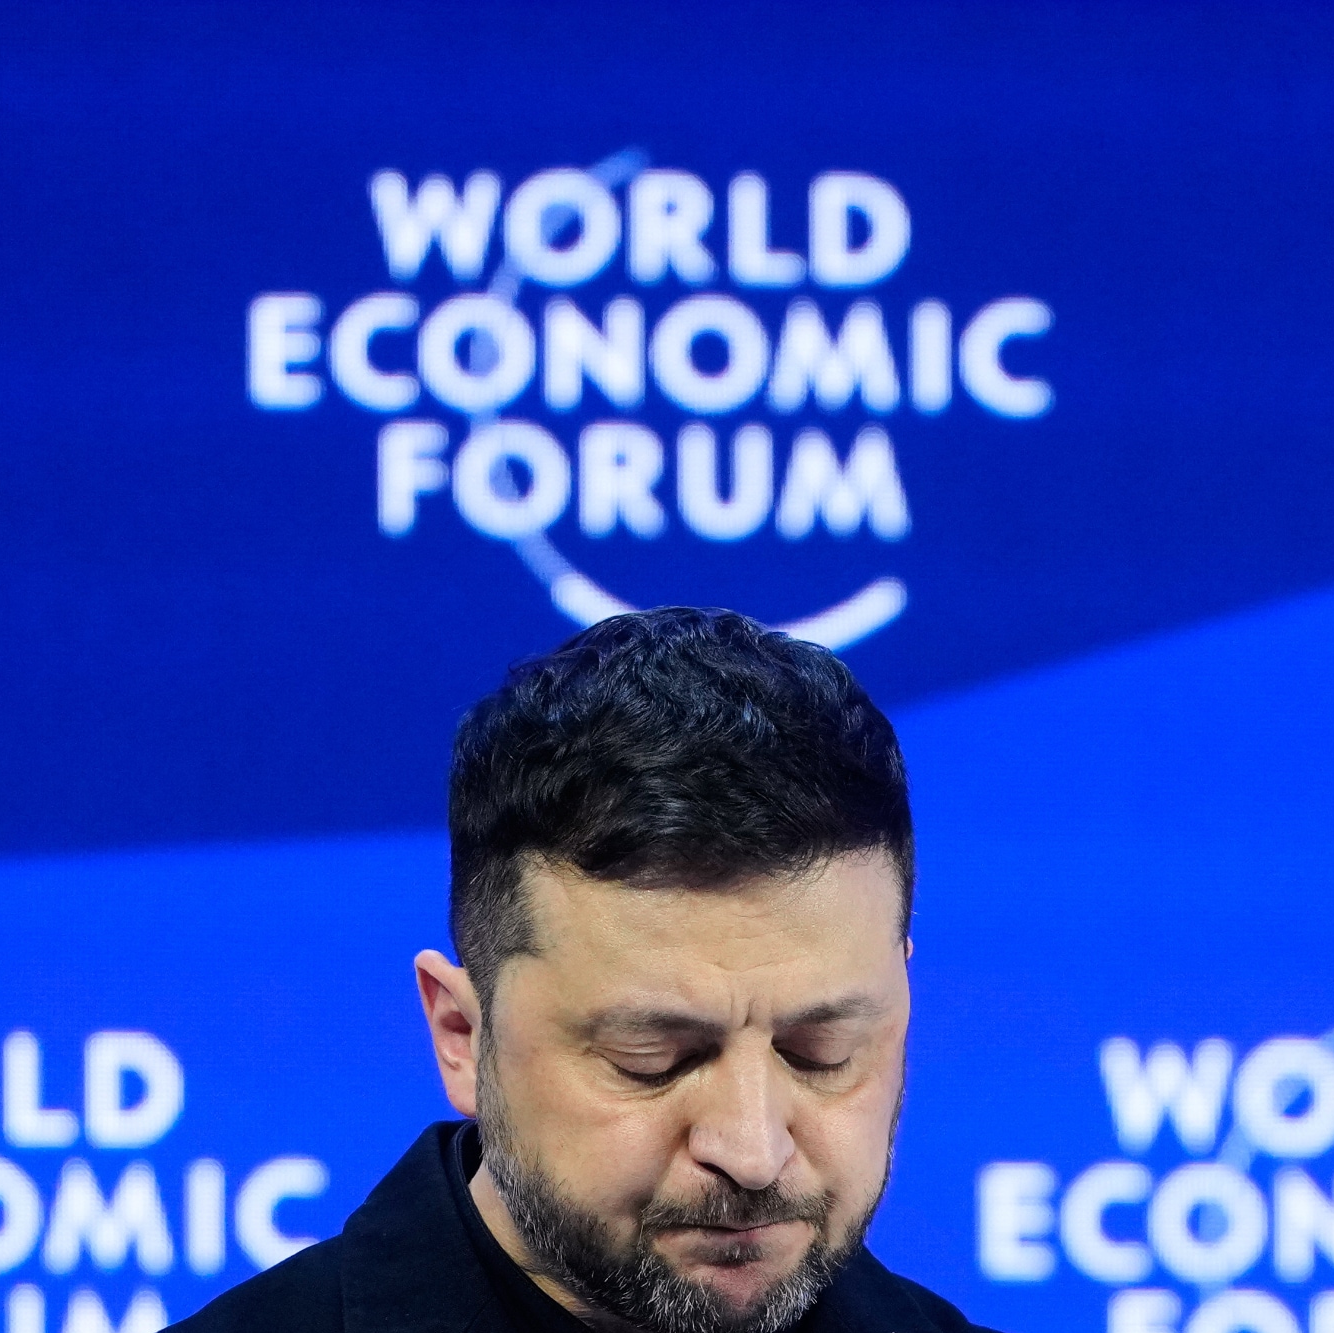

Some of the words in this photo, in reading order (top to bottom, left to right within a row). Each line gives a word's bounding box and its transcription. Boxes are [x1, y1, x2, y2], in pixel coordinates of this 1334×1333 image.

[371, 168, 911, 287] WORLD
[248, 291, 1053, 418] ECONOMIC
[377, 419, 911, 541] FORUM
